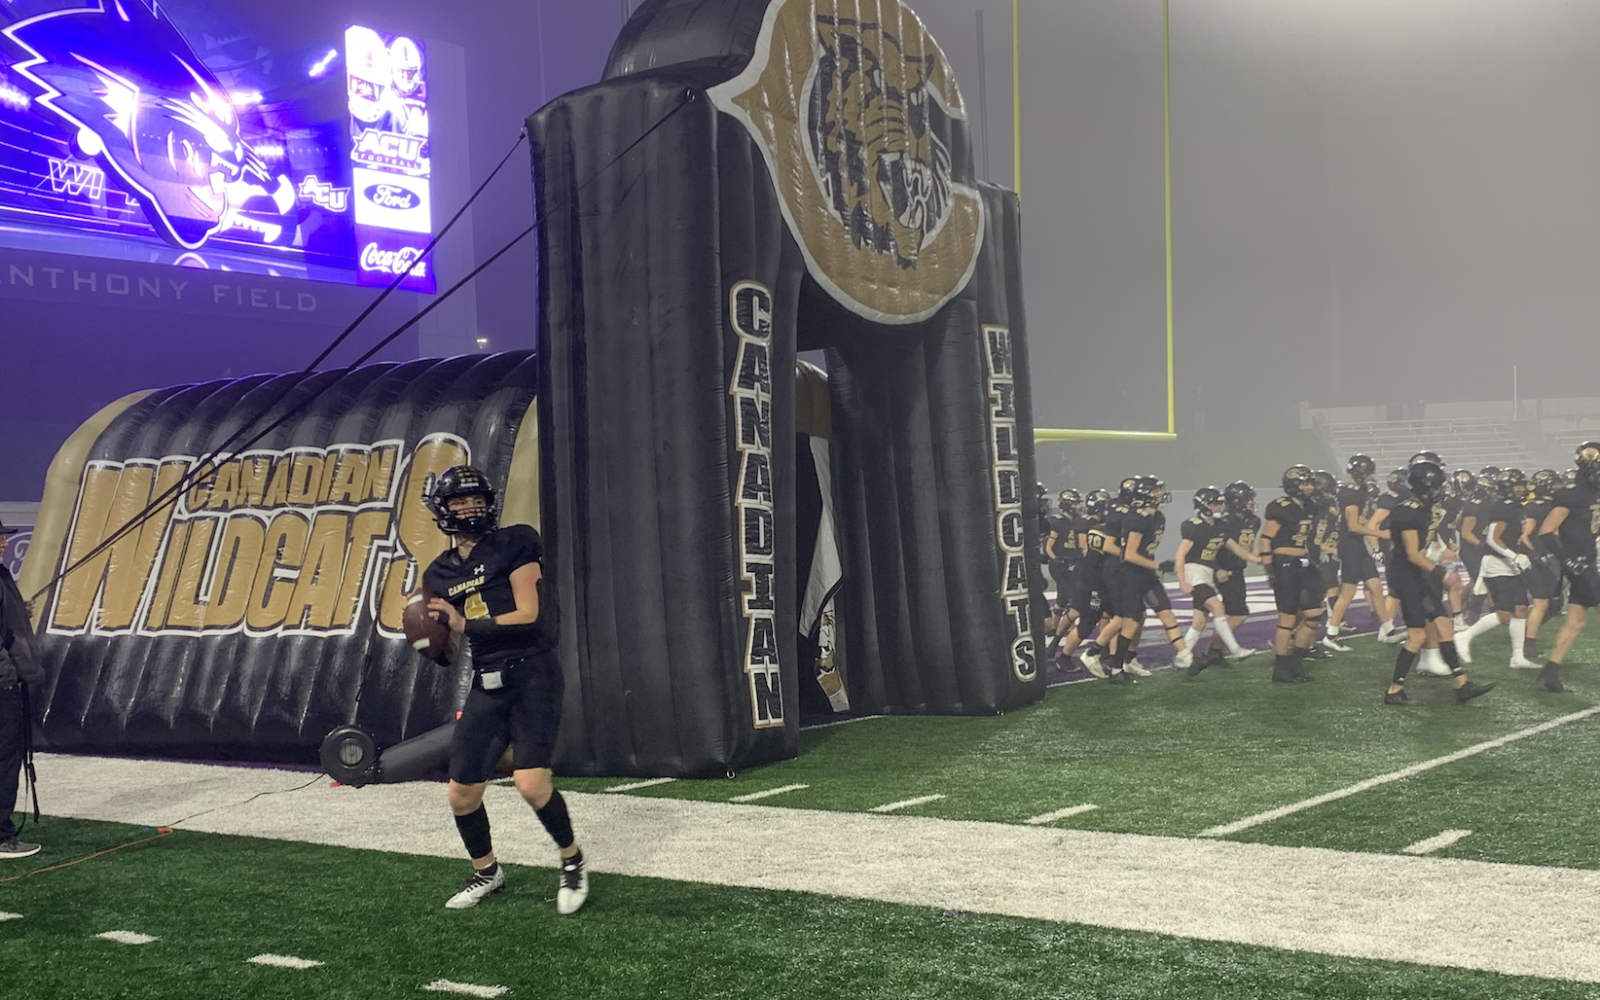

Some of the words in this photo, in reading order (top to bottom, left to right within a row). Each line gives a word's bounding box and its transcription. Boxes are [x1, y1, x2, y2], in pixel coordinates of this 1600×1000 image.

[357, 132, 420, 161] ACU
[360, 153, 420, 169] FOOTBALL
[298, 174, 350, 212] ACU
[373, 184, 411, 209] Ford
[0, 264, 188, 300] NTHONY
[214, 284, 317, 312] FIELD
[185, 443, 402, 510] CANADIAN
[728, 280, 785, 729] CANADIAN
[981, 324, 1038, 683] WILDCATS
[448, 575, 485, 597] CANADIAN
